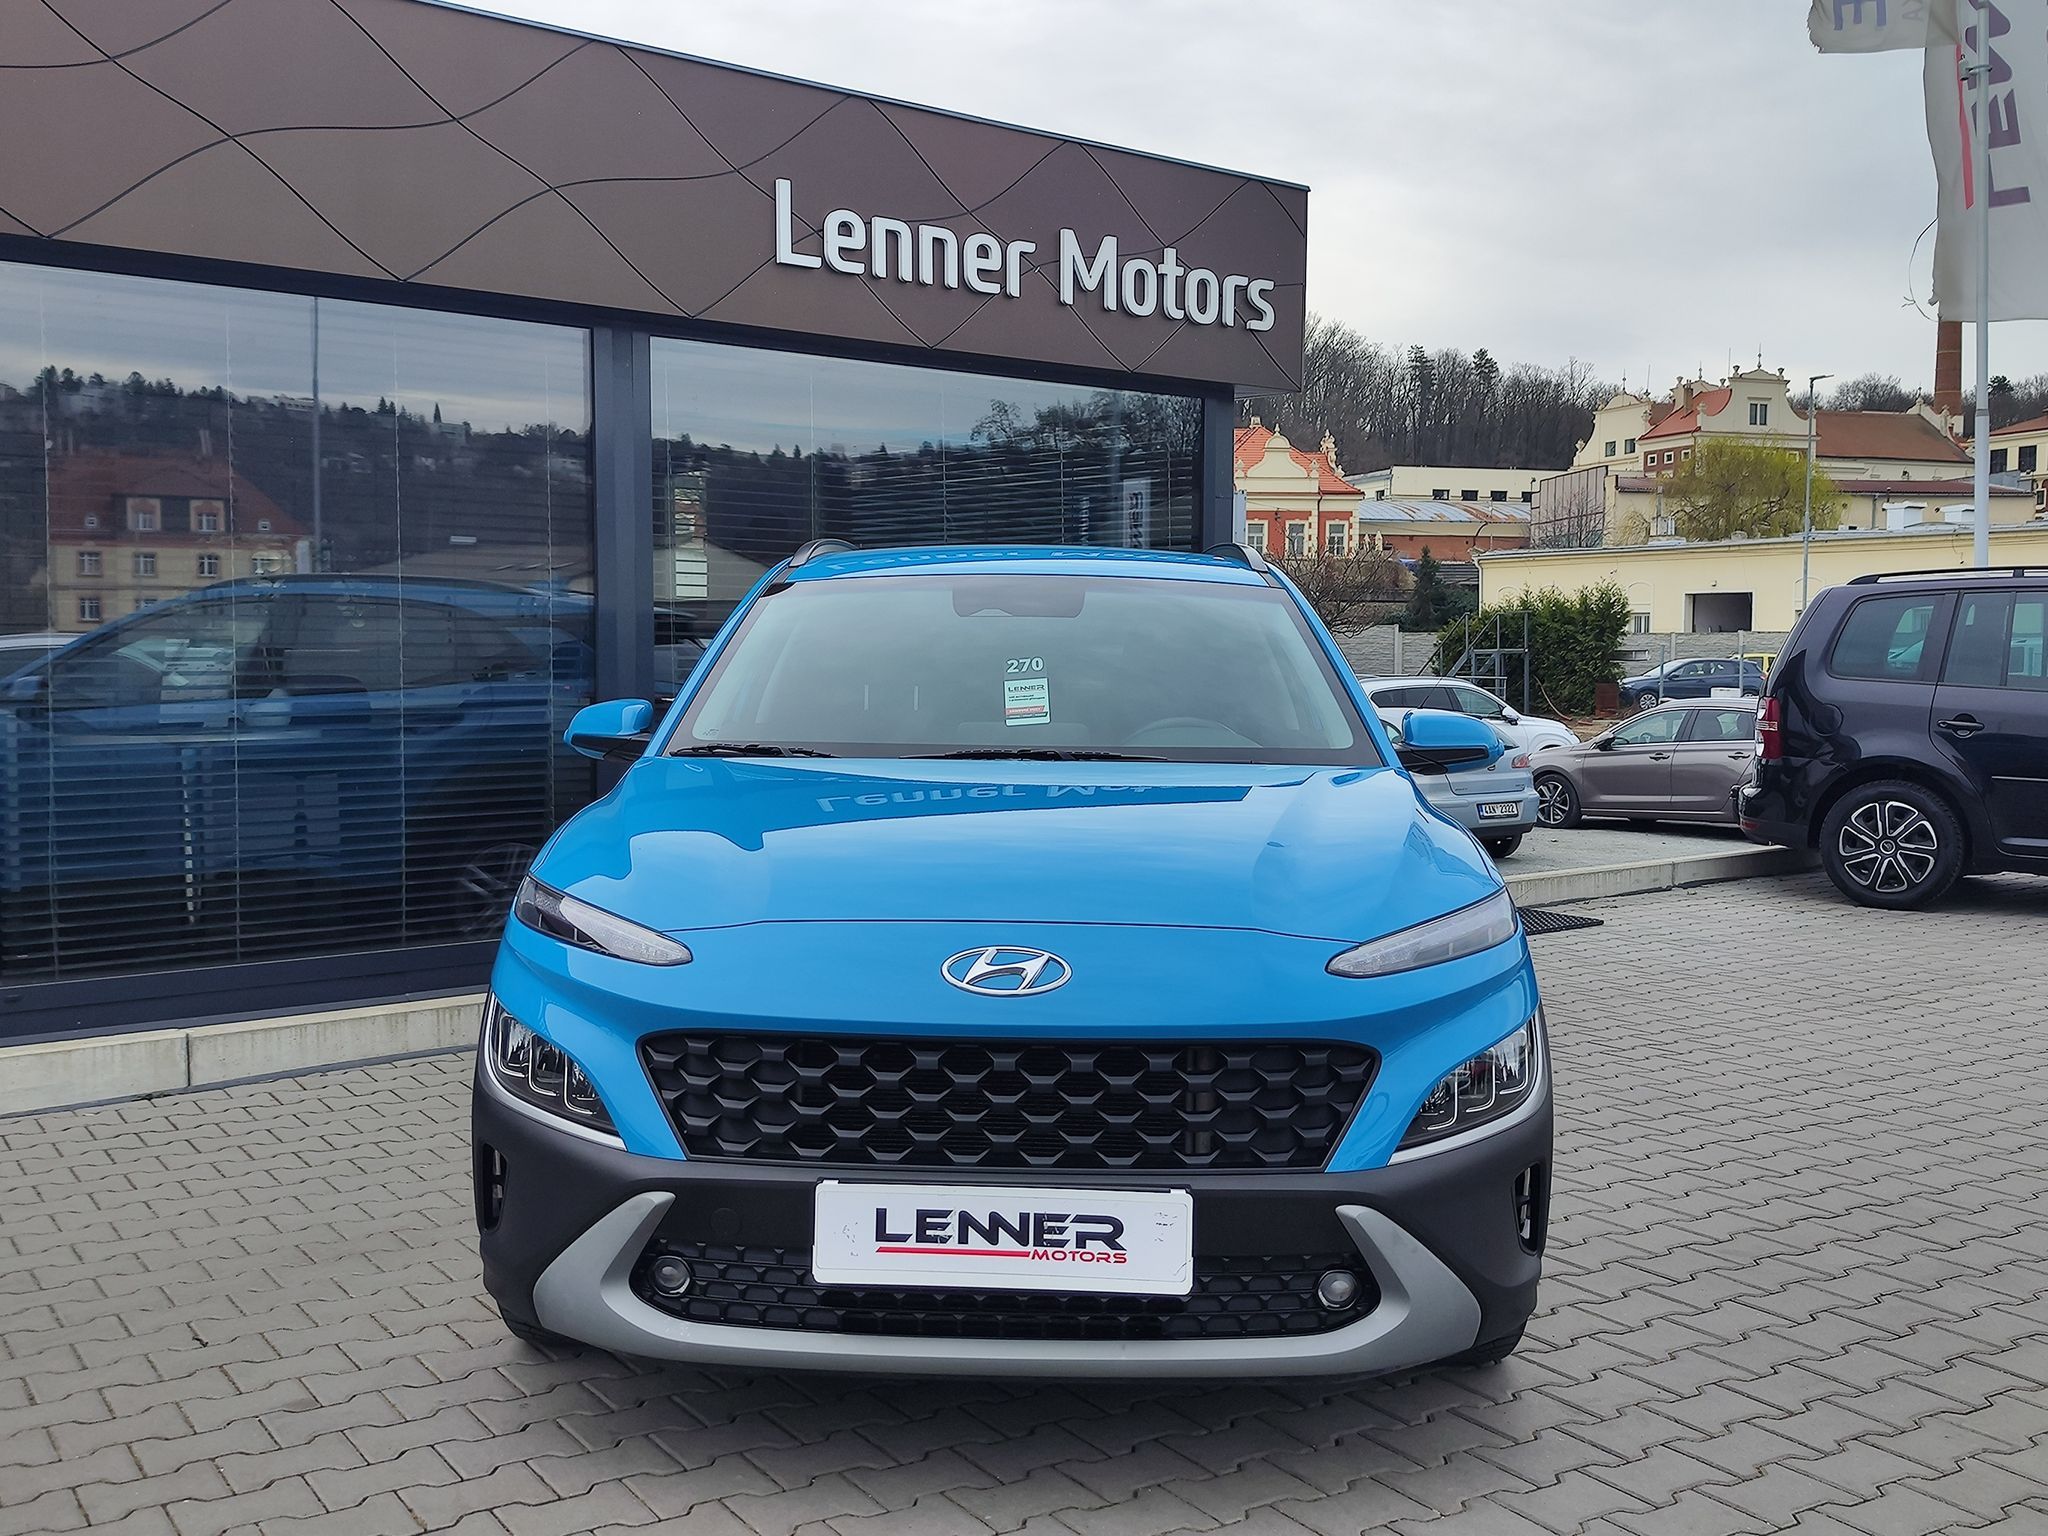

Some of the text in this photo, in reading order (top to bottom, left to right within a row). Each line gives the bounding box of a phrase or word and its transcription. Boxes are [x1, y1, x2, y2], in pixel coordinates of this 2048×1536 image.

[774, 177, 1277, 332] Lenner Motors
[1006, 657, 1044, 673] 270
[1008, 685, 1046, 693] LENNER
[875, 1207, 1128, 1264] LENNER MOTORS
